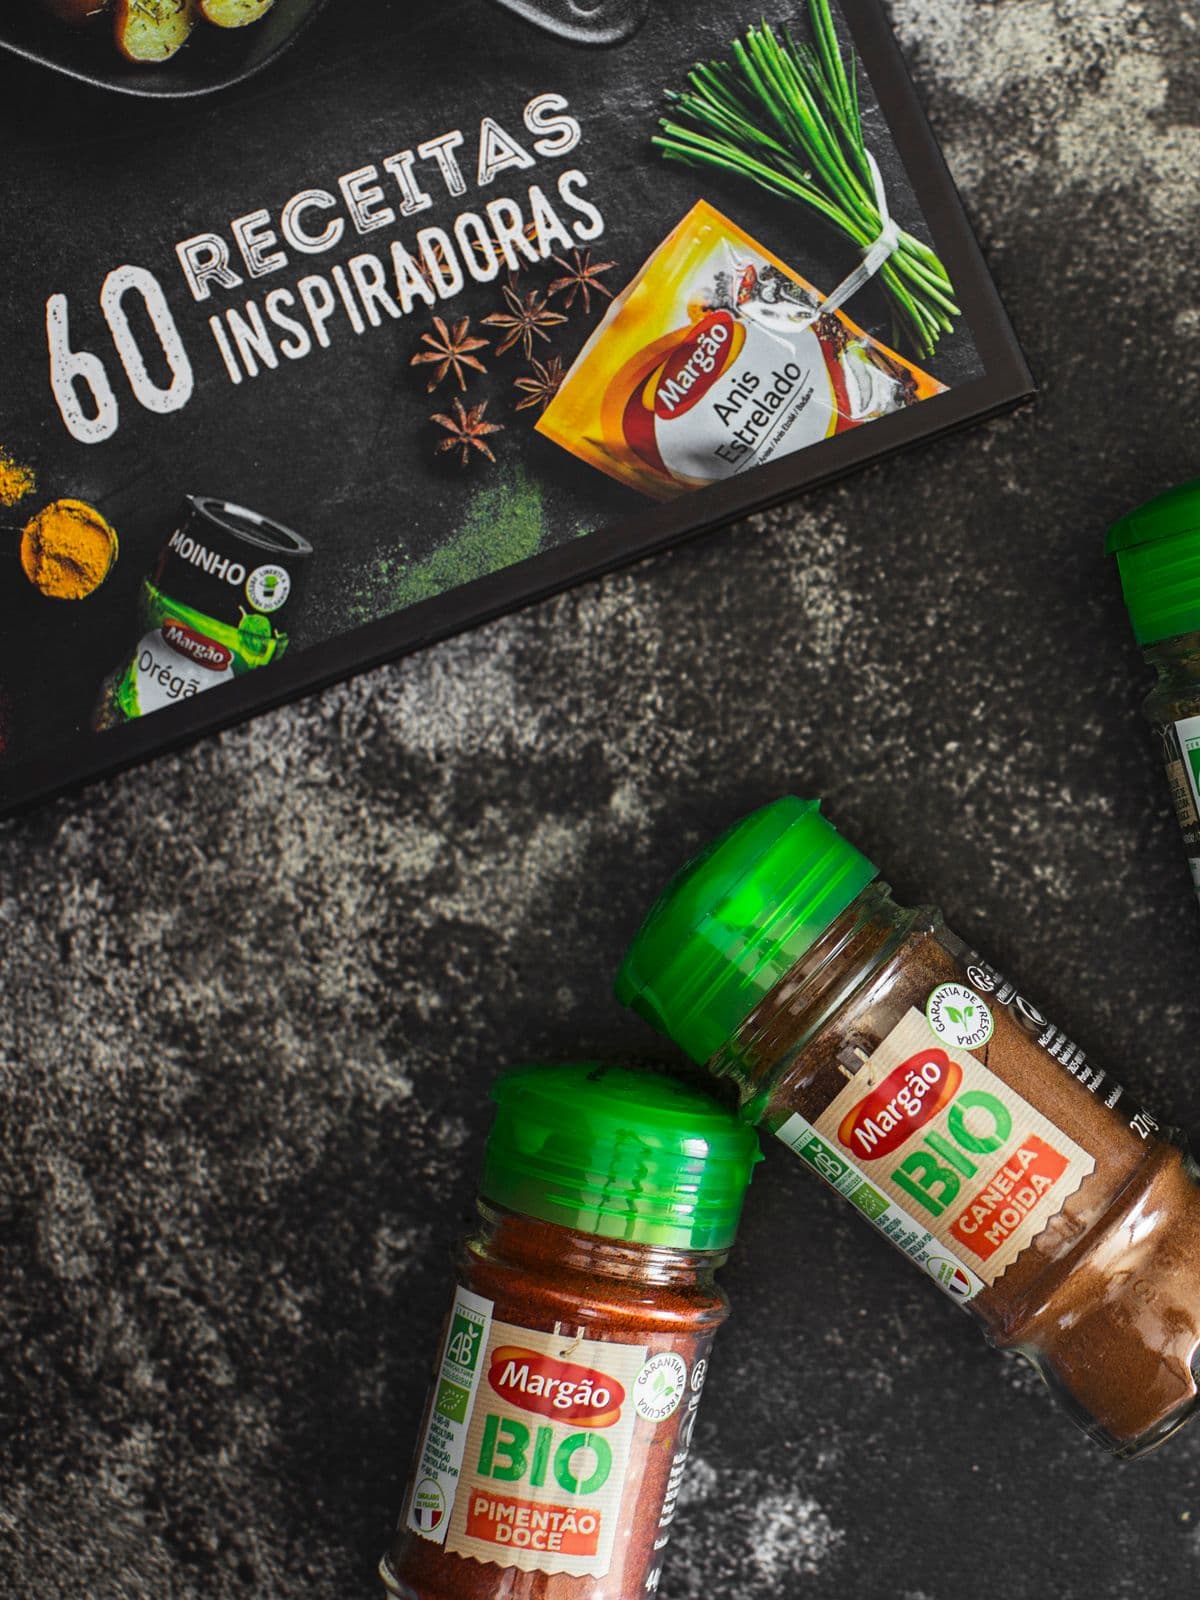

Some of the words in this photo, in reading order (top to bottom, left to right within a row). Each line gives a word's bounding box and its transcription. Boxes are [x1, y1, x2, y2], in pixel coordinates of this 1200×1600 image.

[176, 94, 583, 301] RECEITAS
[47, 264, 195, 444] 60
[207, 169, 606, 385] INSPIRADORAS
[657, 323, 727, 411] Margão
[713, 370, 760, 427] Anis
[715, 362, 801, 465] Estrelado
[168, 529, 246, 585] MOINHO
[166, 627, 225, 664] Margão
[931, 987, 960, 1032] GARANTIA
[957, 1004, 989, 1045] FRESCURA
[963, 990, 977, 1004] DE
[854, 1062, 942, 1153] Margão
[890, 1089, 1012, 1217] BIO
[958, 1147, 1038, 1235] CANELA
[984, 1172, 1052, 1245] MOÍDA
[448, 1331, 473, 1366] AB
[638, 1357, 682, 1385] GARANTIA
[498, 1361, 610, 1410] Margão
[637, 1392, 680, 1419] FRESCURA
[476, 1414, 612, 1496] BIO
[473, 1497, 596, 1535] PIMENTÃO
[495, 1525, 562, 1551] DOCE
